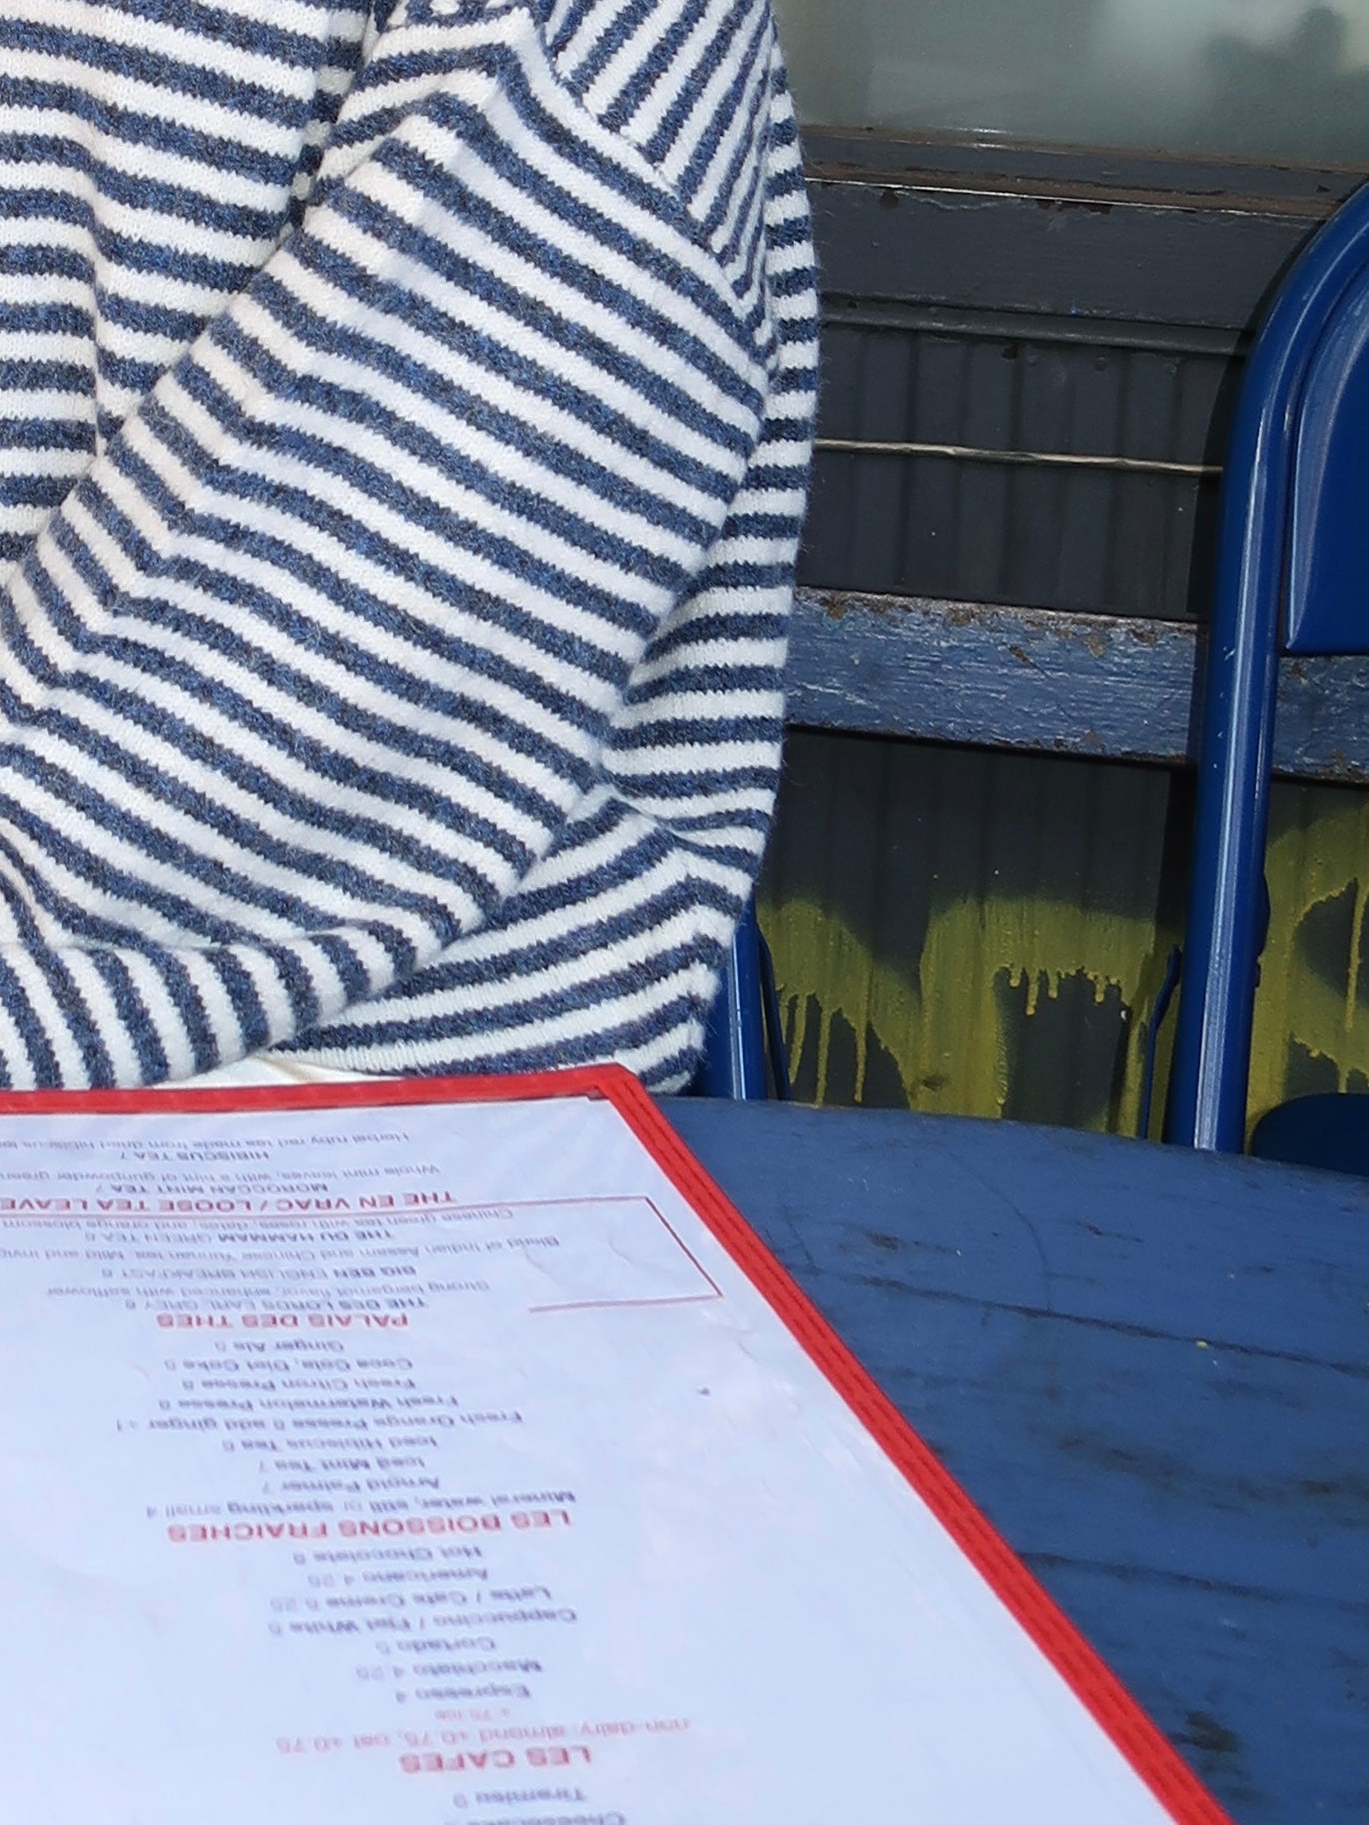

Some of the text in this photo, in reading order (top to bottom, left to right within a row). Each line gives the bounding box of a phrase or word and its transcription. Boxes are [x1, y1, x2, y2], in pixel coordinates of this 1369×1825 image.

[22, 1141, 95, 1151] hibiscus
[100, 1141, 143, 1149] dried
[148, 1141, 187, 1149] from
[193, 1141, 241, 1149] made
[278, 1139, 306, 1148] red
[311, 1135, 348, 1145] ruby
[134, 1151, 171, 1161] TEA
[177, 1151, 269, 1161] HIBISCUS
[0, 1171, 50, 1180] green
[342, 1168, 379, 1179] mint
[384, 1164, 440, 1176] Whole
[58, 1172, 155, 1181] gunpowder
[161, 1174, 177, 1182] of
[182, 1173, 215, 1182] hint
[235, 1173, 272, 1183] with
[111, 1185, 147, 1193] TEA
[157, 1184, 204, 1193] MINT
[210, 1183, 328, 1194] MOROCCAN
[278, 1198, 350, 1210] VRAC
[359, 1195, 394, 1208] EN
[404, 1191, 453, 1205] THE
[97, 1200, 146, 1211] TEA
[161, 1200, 251, 1212] LOOSE
[382, 1212, 436, 1225] green
[435, 1208, 513, 1221] Chinese
[3, 1218, 82, 1231] blossom
[86, 1217, 148, 1229] orange
[154, 1222, 187, 1230] and
[312, 1220, 349, 1229] with
[355, 1218, 382, 1226] tea
[103, 1233, 137, 1242] TEA
[144, 1234, 211, 1243] GREEN
[218, 1233, 314, 1242] HAMMAM
[320, 1232, 349, 1241] DU
[355, 1230, 391, 1240] THE
[425, 1242, 481, 1254] Indian
[485, 1241, 502, 1251] of
[507, 1236, 559, 1249] Blend
[45, 1250, 79, 1260] and
[85, 1250, 124, 1260] Mild
[243, 1251, 315, 1261] Chinese
[320, 1249, 354, 1260] and
[360, 1247, 419, 1257] Assam
[122, 1269, 235, 1279] BREAKFAST
[240, 1269, 328, 1280] ENGLISH
[333, 1268, 375, 1278] BEN
[380, 1266, 416, 1276] BIG
[136, 1287, 174, 1297] with
[180, 1287, 270, 1298] enhanced
[337, 1284, 427, 1297] bergamot
[428, 1281, 490, 1292] Strong
[145, 1296, 425, 1311] THE DES LORDS EARL GREY
[157, 1313, 408, 1328] PALAIS DES THES
[234, 1339, 344, 1352] Ginger Ale
[183, 1359, 239, 1372] Coke
[247, 1360, 290, 1371] Diet
[356, 1358, 413, 1369] Coca
[281, 1379, 348, 1390] Citron
[354, 1379, 416, 1390] Fresh
[260, 1398, 392, 1411] Watermelon
[397, 1396, 458, 1408] Fresh
[149, 1417, 217, 1431] ginger
[374, 1415, 455, 1427] Orange
[460, 1411, 523, 1425] Fresh
[225, 1420, 265, 1431] add
[241, 1436, 438, 1452] Iced Hibiscus Tea
[275, 1460, 314, 1472] Tea
[321, 1459, 370, 1471] Mint
[376, 1457, 425, 1470] Iced
[282, 1481, 361, 1492] Palmer
[367, 1477, 439, 1491] Arnold
[416, 1496, 484, 1508] water,
[491, 1491, 576, 1506] Mineral
[165, 1504, 221, 1518] small
[227, 1500, 333, 1515] sparkling
[369, 1501, 408, 1513] still
[168, 1510, 570, 1542] LES BOISSONS FRAICHES
[313, 1546, 482, 1563] Hot Chocolate
[363, 1568, 488, 1582] Americano
[490, 1586, 551, 1601] Latte
[366, 1617, 411, 1631] Flat
[433, 1609, 578, 1627] Cappuccino
[290, 1620, 360, 1634] White
[397, 1637, 496, 1653] Cortado
[413, 1659, 543, 1677] Macchiato
[415, 1684, 532, 1700] Espresso
[479, 1725, 566, 1743] almond
[276, 1736, 343, 1755] +0.75
[353, 1734, 391, 1749] oat
[399, 1746, 591, 1773] LES CAFES
[476, 1787, 586, 1805] Tiramisu
